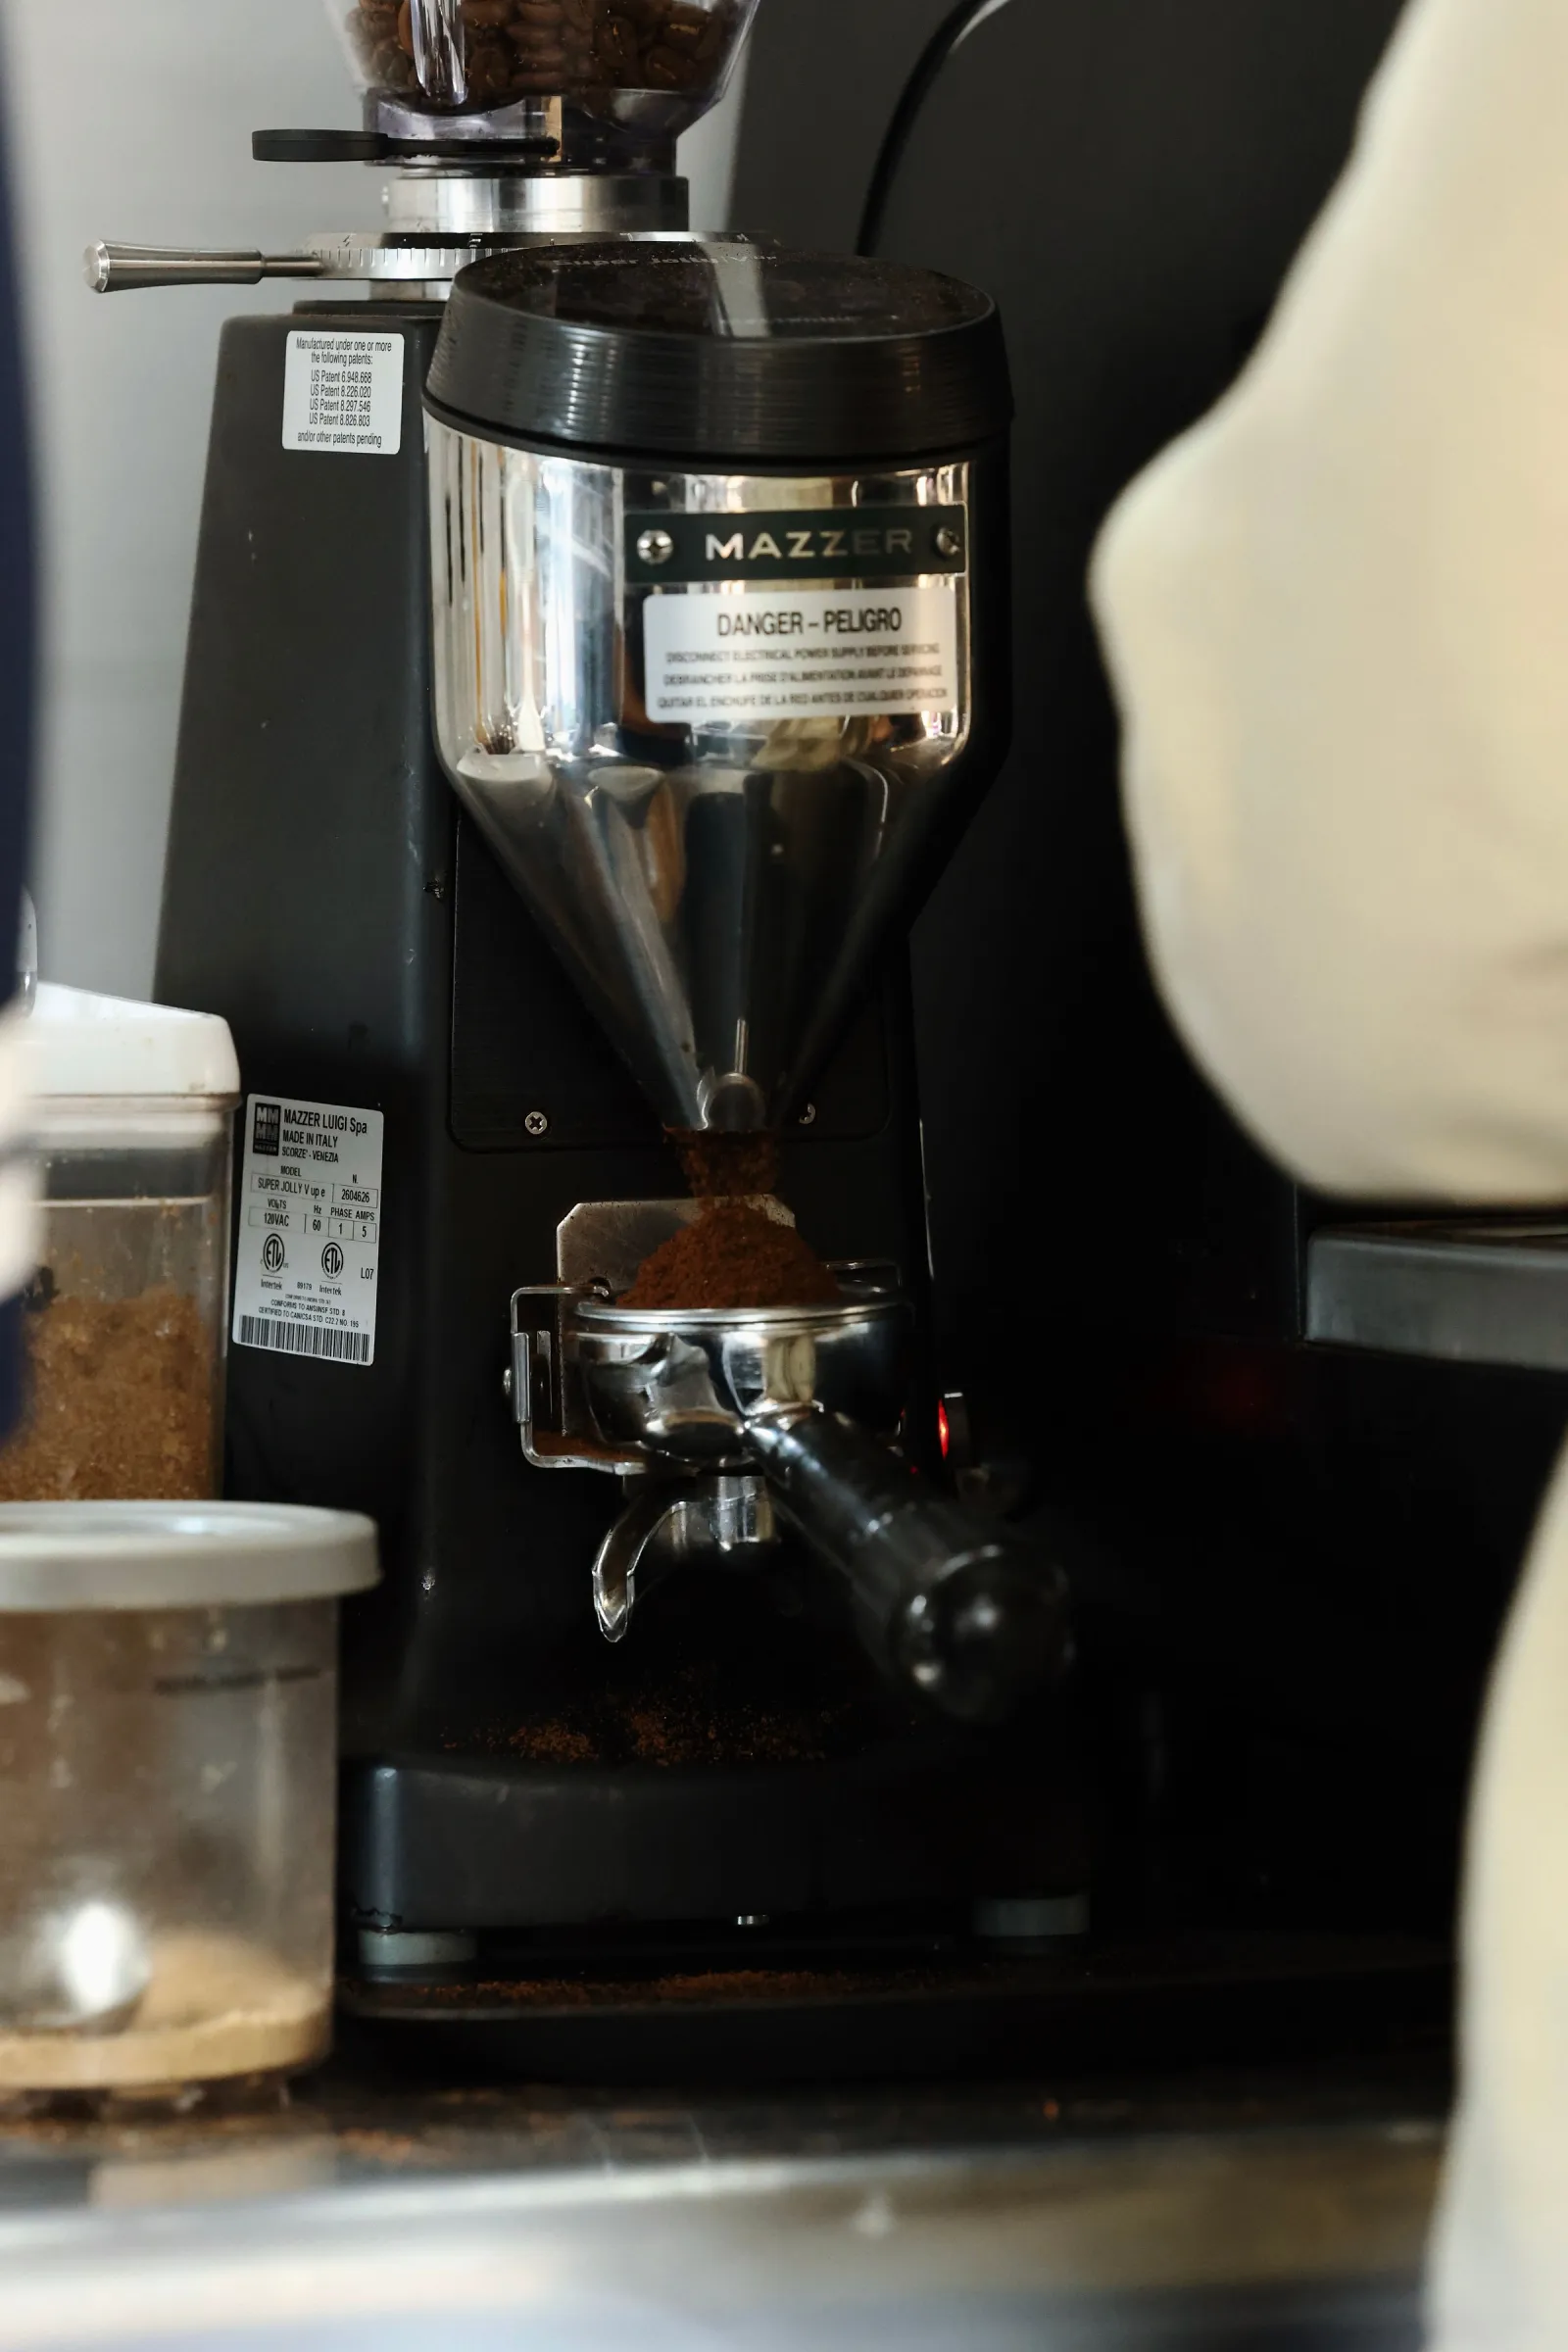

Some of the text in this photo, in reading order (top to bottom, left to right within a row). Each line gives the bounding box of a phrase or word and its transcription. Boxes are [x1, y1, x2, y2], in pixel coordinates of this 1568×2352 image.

[296, 337, 334, 350] Manufactured
[335, 339, 353, 351] under
[354, 342, 366, 351] one
[375, 342, 392, 352] more
[311, 352, 373, 368] the following patents:
[311, 369, 372, 384] US Patent 6.948.668
[310, 384, 371, 399] US Patent 8.226.020
[310, 398, 370, 413] US Patent 8.297.546
[309, 413, 370, 427] US Patent 8.826.803
[297, 430, 382, 449] and/or other patents pending
[705, 529, 913, 561] MAZZER
[717, 612, 803, 637] DANGER
[823, 608, 903, 634] PELIGRO
[283, 1108, 368, 1136] MAZZER LUIGI Spa
[282, 1129, 338, 1148] MADE IN ITALY
[312, 1151, 339, 1163] VENEZIA
[280, 1165, 302, 1177] MODEL
[258, 1178, 325, 1199] SUPER JOLLY V up e
[341, 1188, 370, 1203] 2604626
[314, 1204, 322, 1215] Hz
[330, 1206, 353, 1218] PHASE
[355, 1210, 375, 1222] AMPS
[264, 1212, 290, 1227] 120VAC
[312, 1219, 321, 1232] 60
[338, 1222, 343, 1235] 1
[362, 1226, 368, 1238] 5
[261, 1279, 283, 1291] Intertek
[318, 1285, 342, 1297] Intertek
[259, 1306, 282, 1317] CERTIFIED
[282, 1309, 290, 1318] TO
[313, 1314, 323, 1323] STD
[270, 1298, 297, 1309] CONFORMS
[328, 1307, 340, 1316] STD
